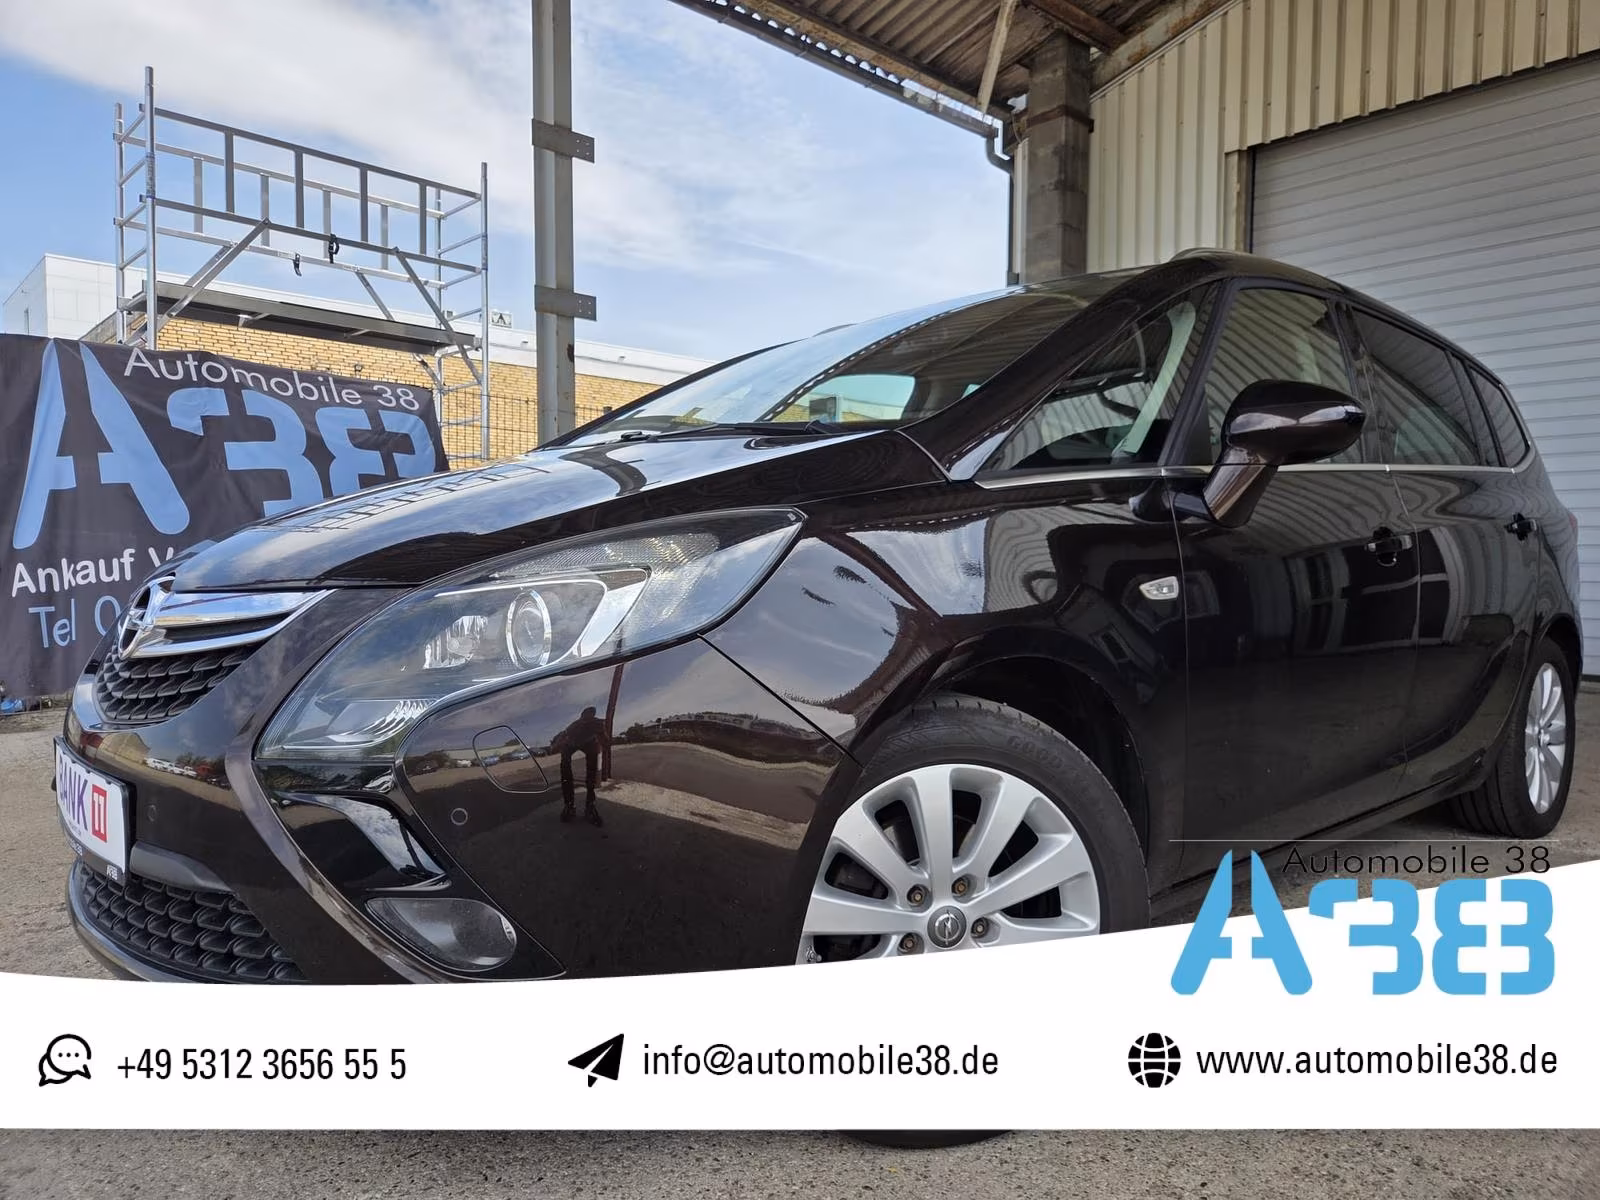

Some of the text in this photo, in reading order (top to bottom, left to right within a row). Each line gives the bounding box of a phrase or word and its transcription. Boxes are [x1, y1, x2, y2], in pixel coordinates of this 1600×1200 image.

[124, 349, 420, 412] Automobile 38
[11, 547, 135, 597] Ankauf
[28, 598, 76, 648] Tel
[58, 753, 89, 831] BANK
